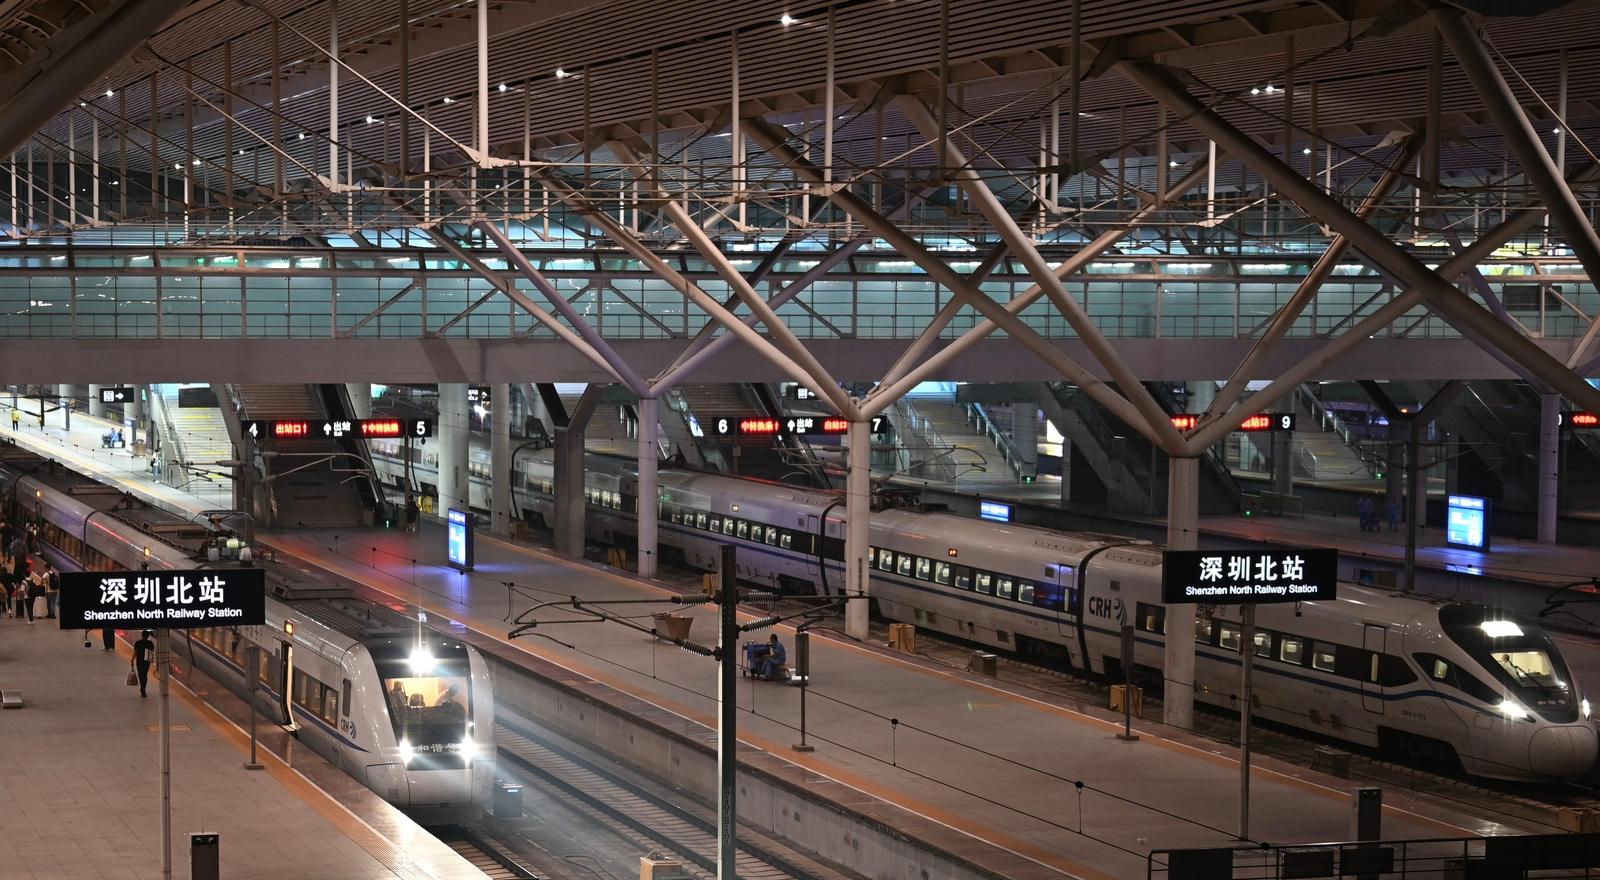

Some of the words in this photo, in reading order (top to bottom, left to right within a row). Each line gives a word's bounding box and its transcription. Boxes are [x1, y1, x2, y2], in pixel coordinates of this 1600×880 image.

[276, 423, 301, 434] 出站口
[333, 421, 351, 431] 出站
[416, 421, 425, 435] 5
[718, 419, 728, 433] 6
[796, 418, 813, 428] 出站
[872, 418, 882, 432] 7
[1281, 416, 1291, 429] 9
[1199, 555, 1305, 582] 深圳北站
[99, 576, 226, 605] 深圳北站
[1185, 586, 1228, 596] Shenzhen
[1230, 585, 1253, 595] North
[1254, 584, 1287, 596] Railway
[1288, 583, 1318, 594] Station
[84, 609, 134, 621] Shenzhen
[136, 608, 164, 619] North
[166, 607, 206, 620] Railway
[208, 607, 243, 618] Station
[1088, 595, 1112, 619] CRH
[340, 719, 350, 734] CRH
